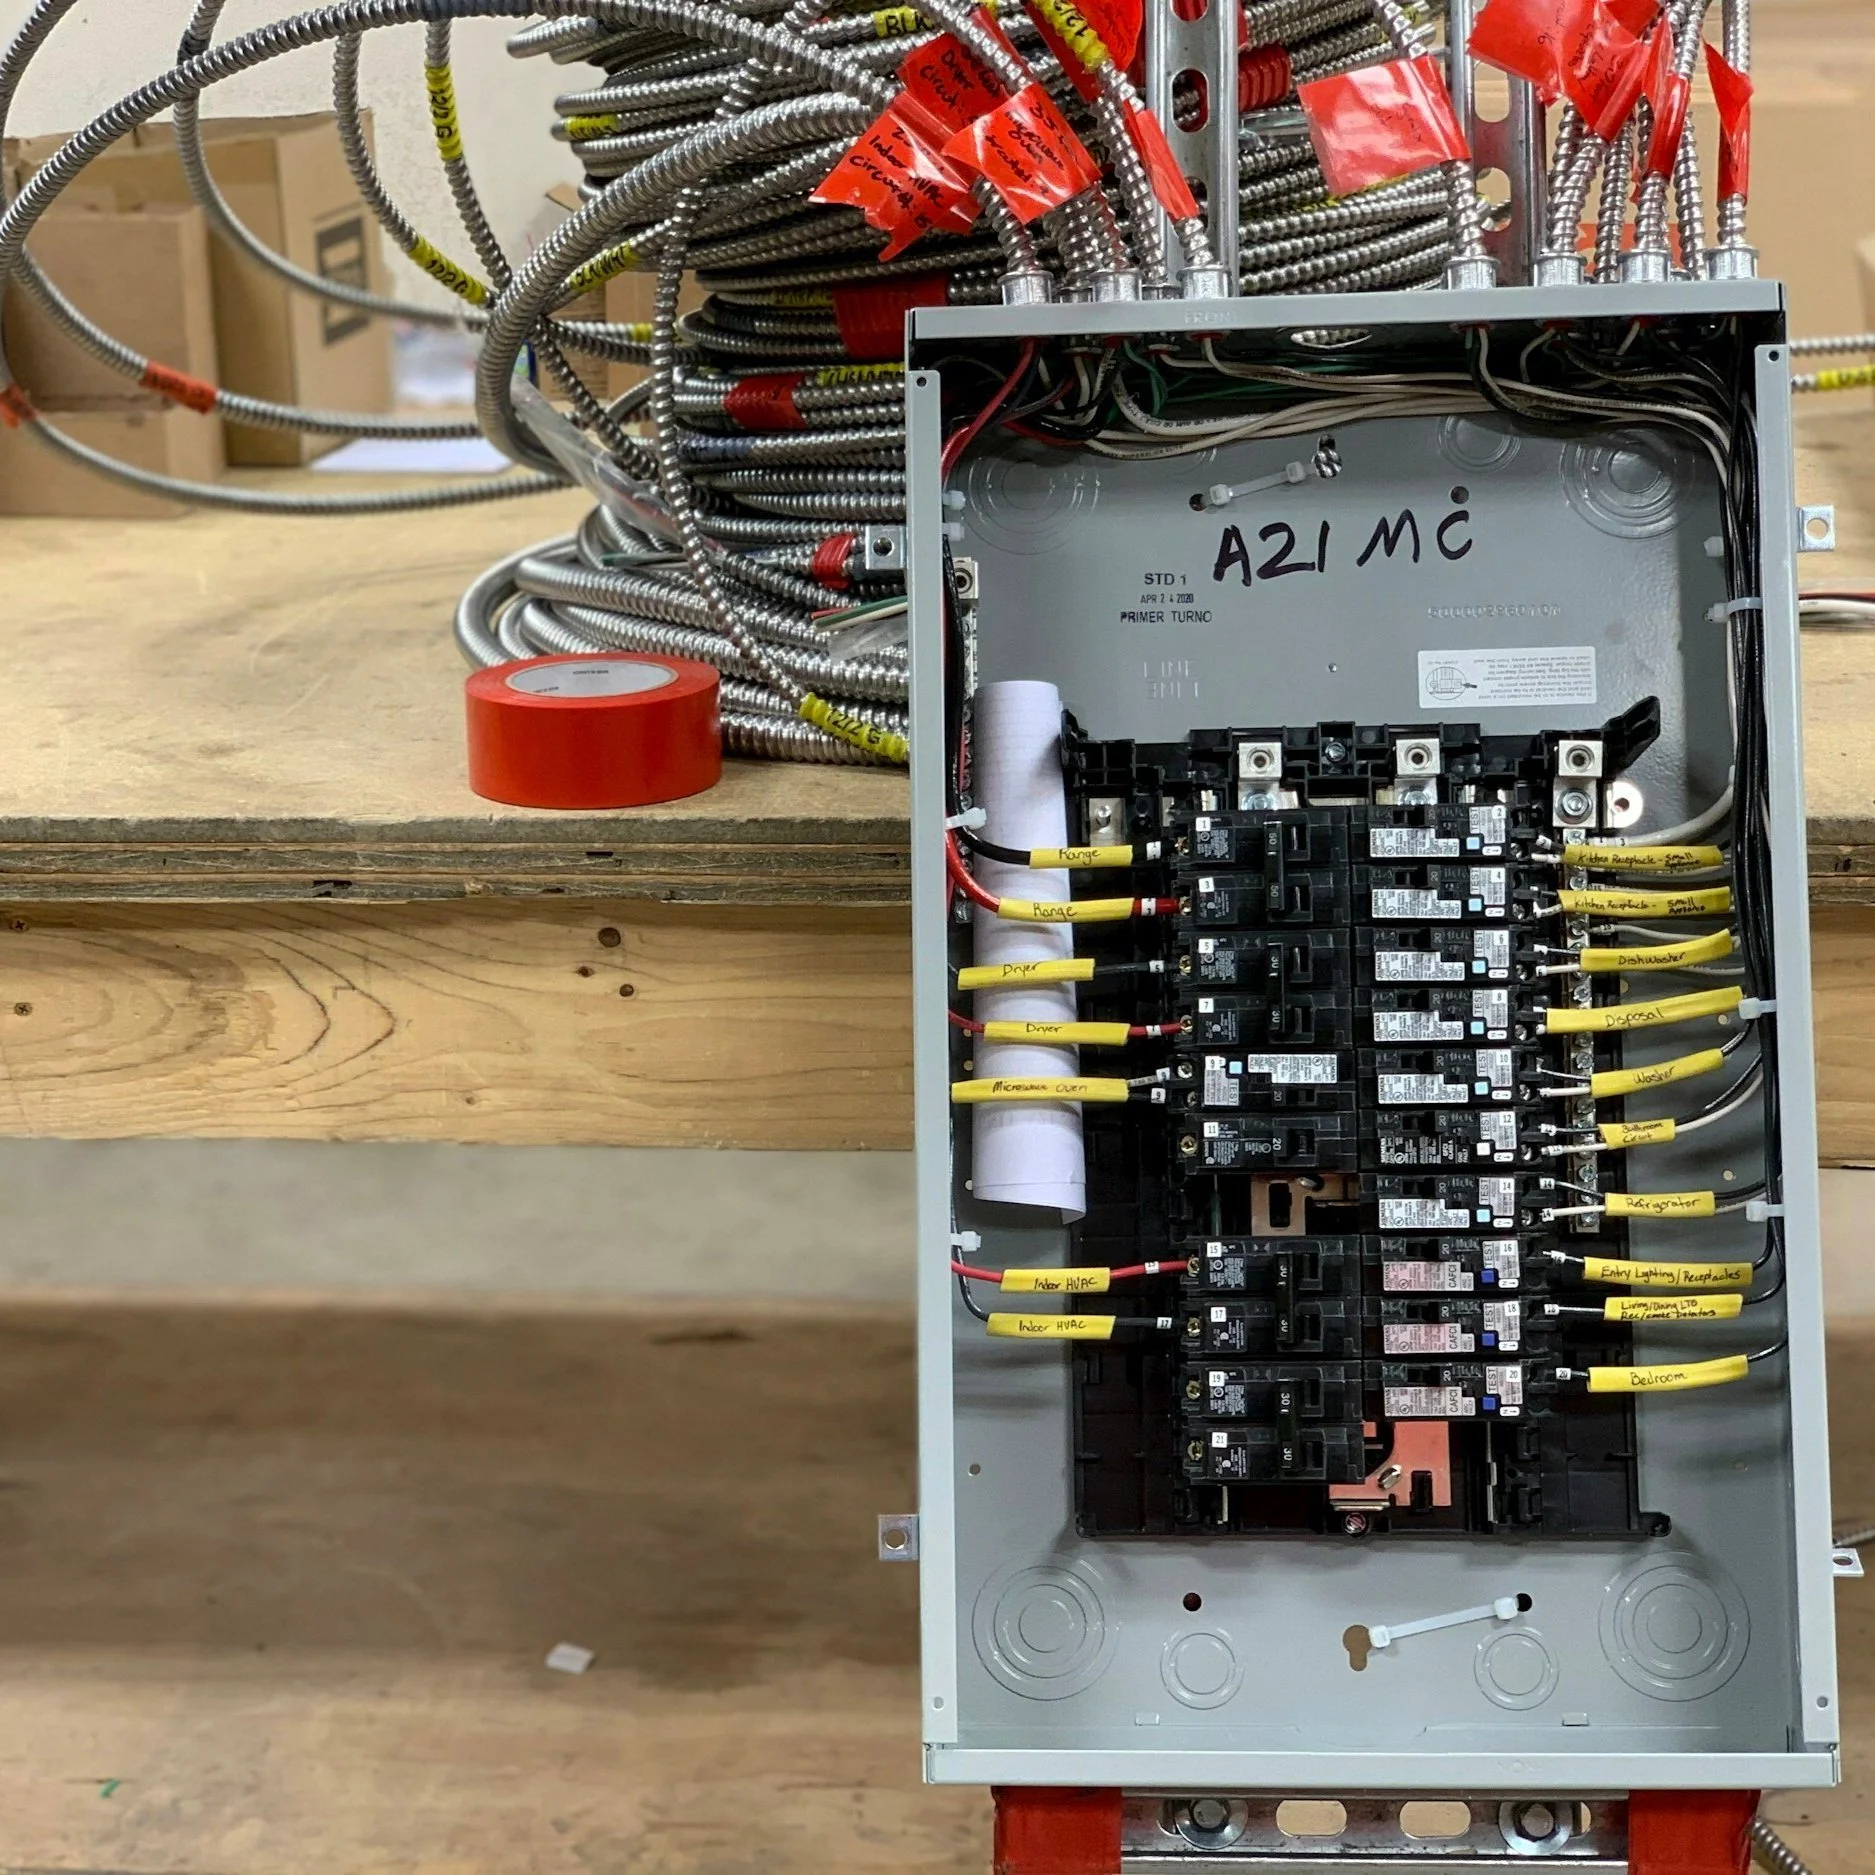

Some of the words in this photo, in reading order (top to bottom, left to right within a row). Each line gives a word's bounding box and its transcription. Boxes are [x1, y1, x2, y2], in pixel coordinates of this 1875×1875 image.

[1213, 520, 1331, 587] A21
[1144, 572, 1175, 585] STD
[1180, 574, 1187, 585] 1
[1140, 594, 1157, 604] APR
[1177, 593, 1194, 604] 2020
[1120, 611, 1164, 623] PRIMER
[1171, 610, 1213, 623] TURNO
[1471, 808, 1479, 833] TEST
[1058, 848, 1101, 866] Range
[1205, 881, 1210, 889] 3
[1033, 904, 1077, 922] Range
[1475, 930, 1483, 956] TEST
[1002, 961, 1041, 977] Dryer
[1474, 991, 1482, 1015] TEST
[1605, 1007, 1665, 1027] Disposal
[1026, 1023, 1063, 1035] Dryer
[1478, 1050, 1486, 1075] TEST
[1500, 1054, 1509, 1063] 10
[1633, 1065, 1676, 1084] Washer
[1229, 1080, 1238, 1105] TEST
[1481, 1112, 1491, 1138] TEST
[1502, 1114, 1512, 1123] 12
[1208, 1126, 1216, 1134] 11
[1481, 1178, 1489, 1202] TEST
[1502, 1181, 1511, 1190] 14
[1485, 1242, 1493, 1267] TEST
[1504, 1243, 1512, 1252] 16
[1601, 1265, 1631, 1280] Entry
[1034, 1278, 1061, 1290] Indoor
[1066, 1276, 1098, 1290] HVAC
[1214, 1310, 1223, 1319] 17
[1508, 1304, 1517, 1313] 18
[1485, 1304, 1493, 1328] TEST
[1018, 1320, 1050, 1332] Indoor
[1056, 1319, 1087, 1330] HVAC
[1212, 1374, 1221, 1383] 19
[1488, 1368, 1496, 1392] TEST
[1509, 1370, 1518, 1379] 20
[1630, 1372, 1687, 1385] Bedroom
[1215, 1435, 1225, 1444] 21
